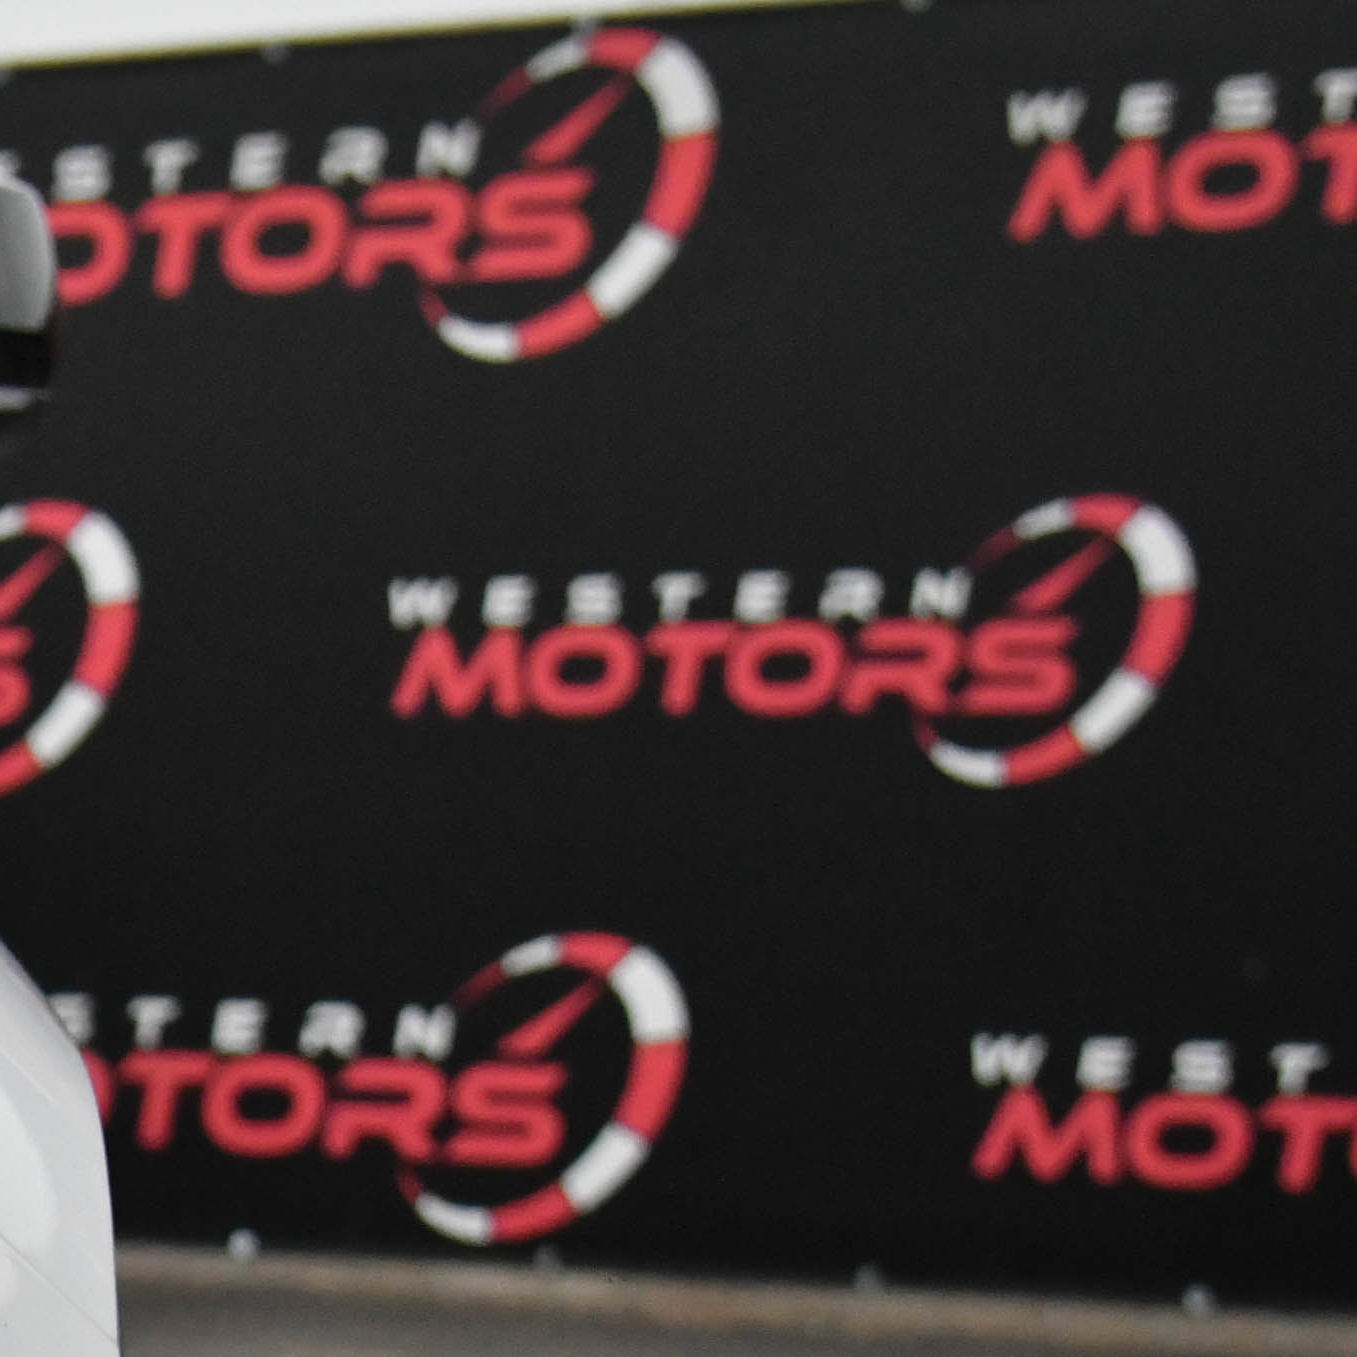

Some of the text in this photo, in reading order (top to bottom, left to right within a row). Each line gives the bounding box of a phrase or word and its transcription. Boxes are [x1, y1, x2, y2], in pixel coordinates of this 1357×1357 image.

[1006, 67, 1357, 146] WEST
[44, 166, 594, 304] OTORS
[1007, 118, 1357, 243] MOT
[388, 566, 974, 628] WESTERN
[390, 614, 1078, 718] MOTORS
[80, 1046, 567, 1168] TORS
[970, 1032, 1330, 1096] WEST
[971, 1080, 1357, 1195] MOT
